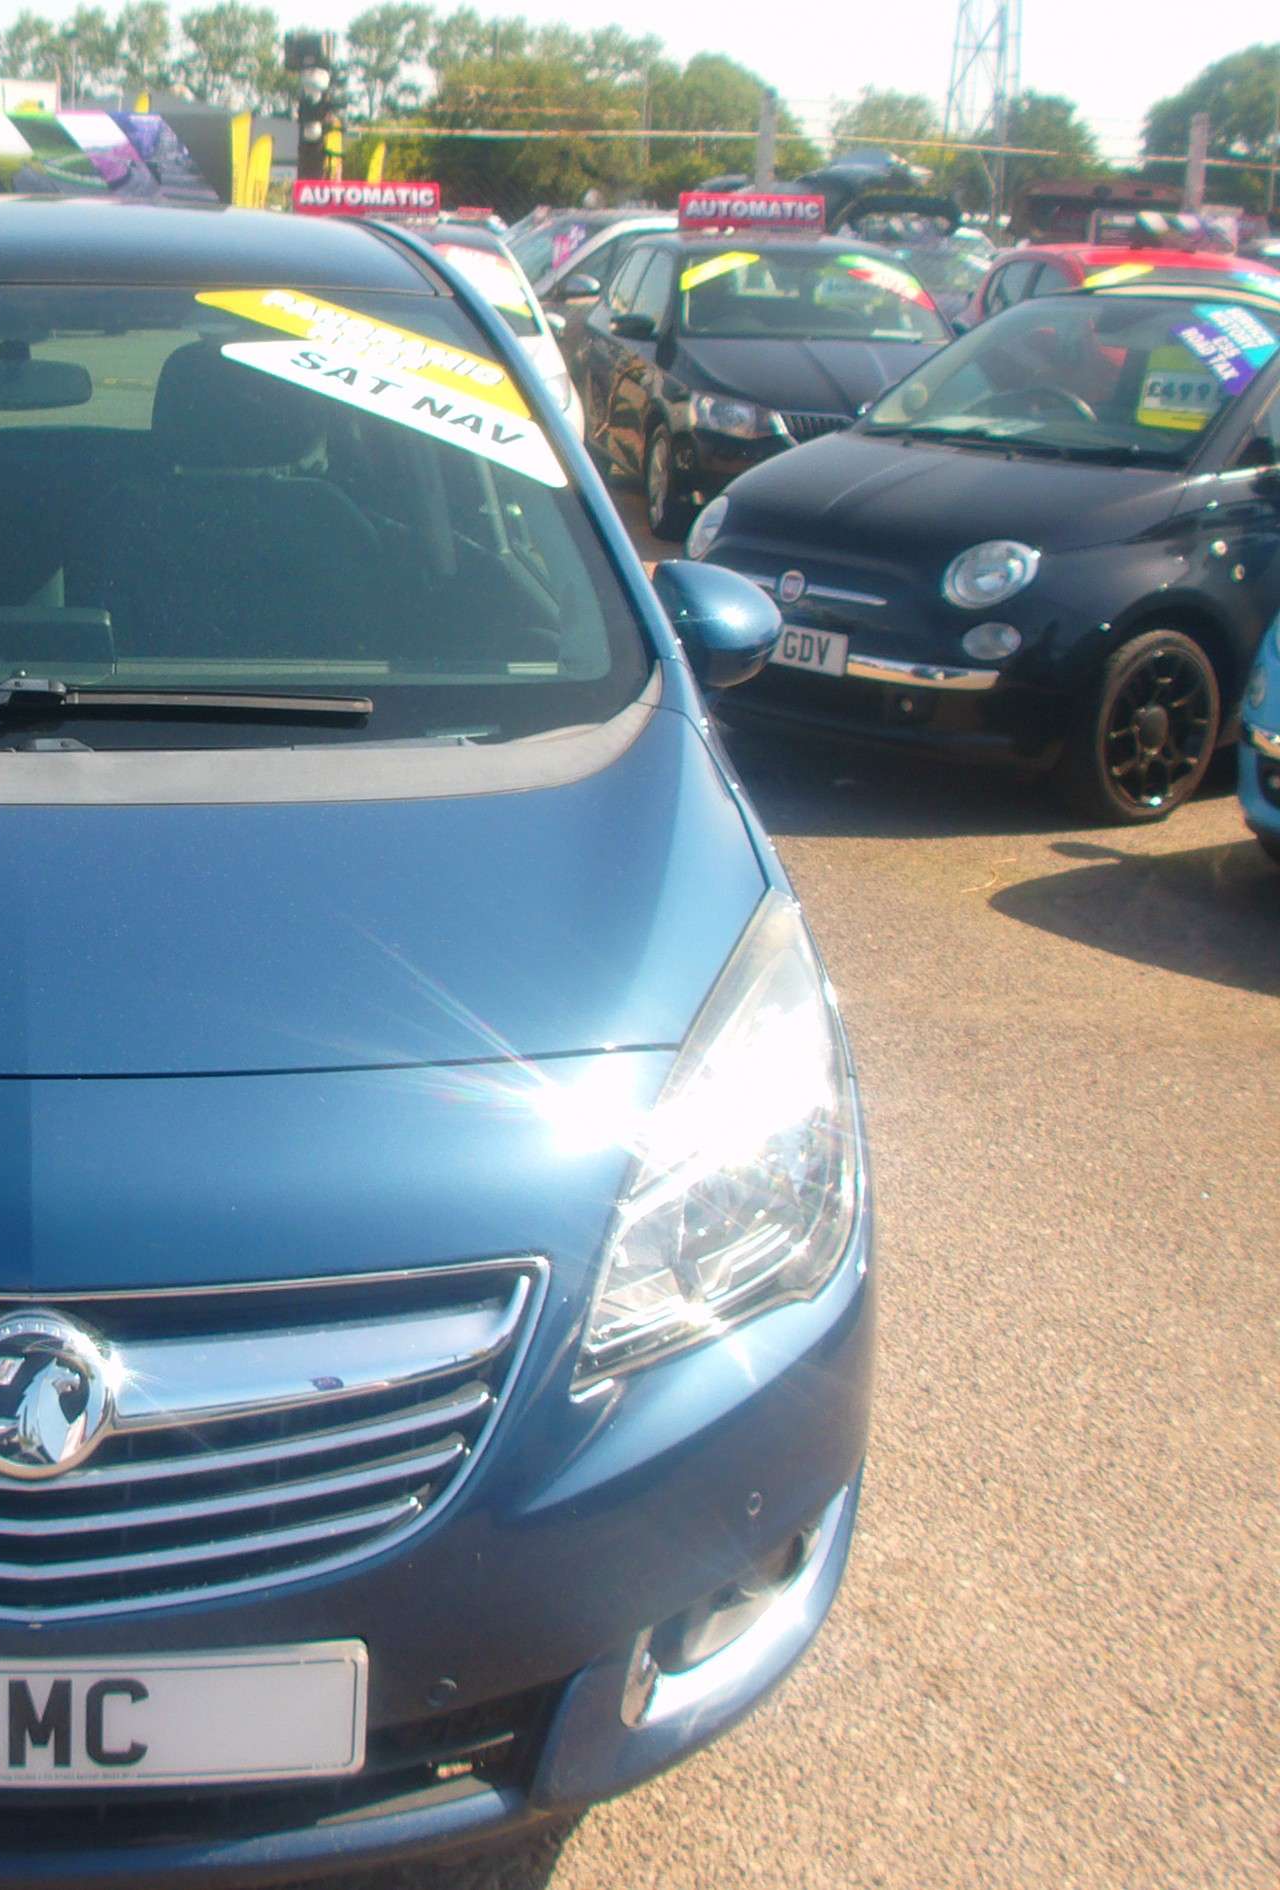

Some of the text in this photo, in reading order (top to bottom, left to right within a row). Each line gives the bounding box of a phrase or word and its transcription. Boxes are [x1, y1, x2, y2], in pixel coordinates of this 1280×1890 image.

[300, 184, 434, 207] AUTOMATIC
[686, 199, 820, 220] AUTOMATIC
[290, 351, 524, 444] SAT NAV
[783, 631, 831, 666] GDV
